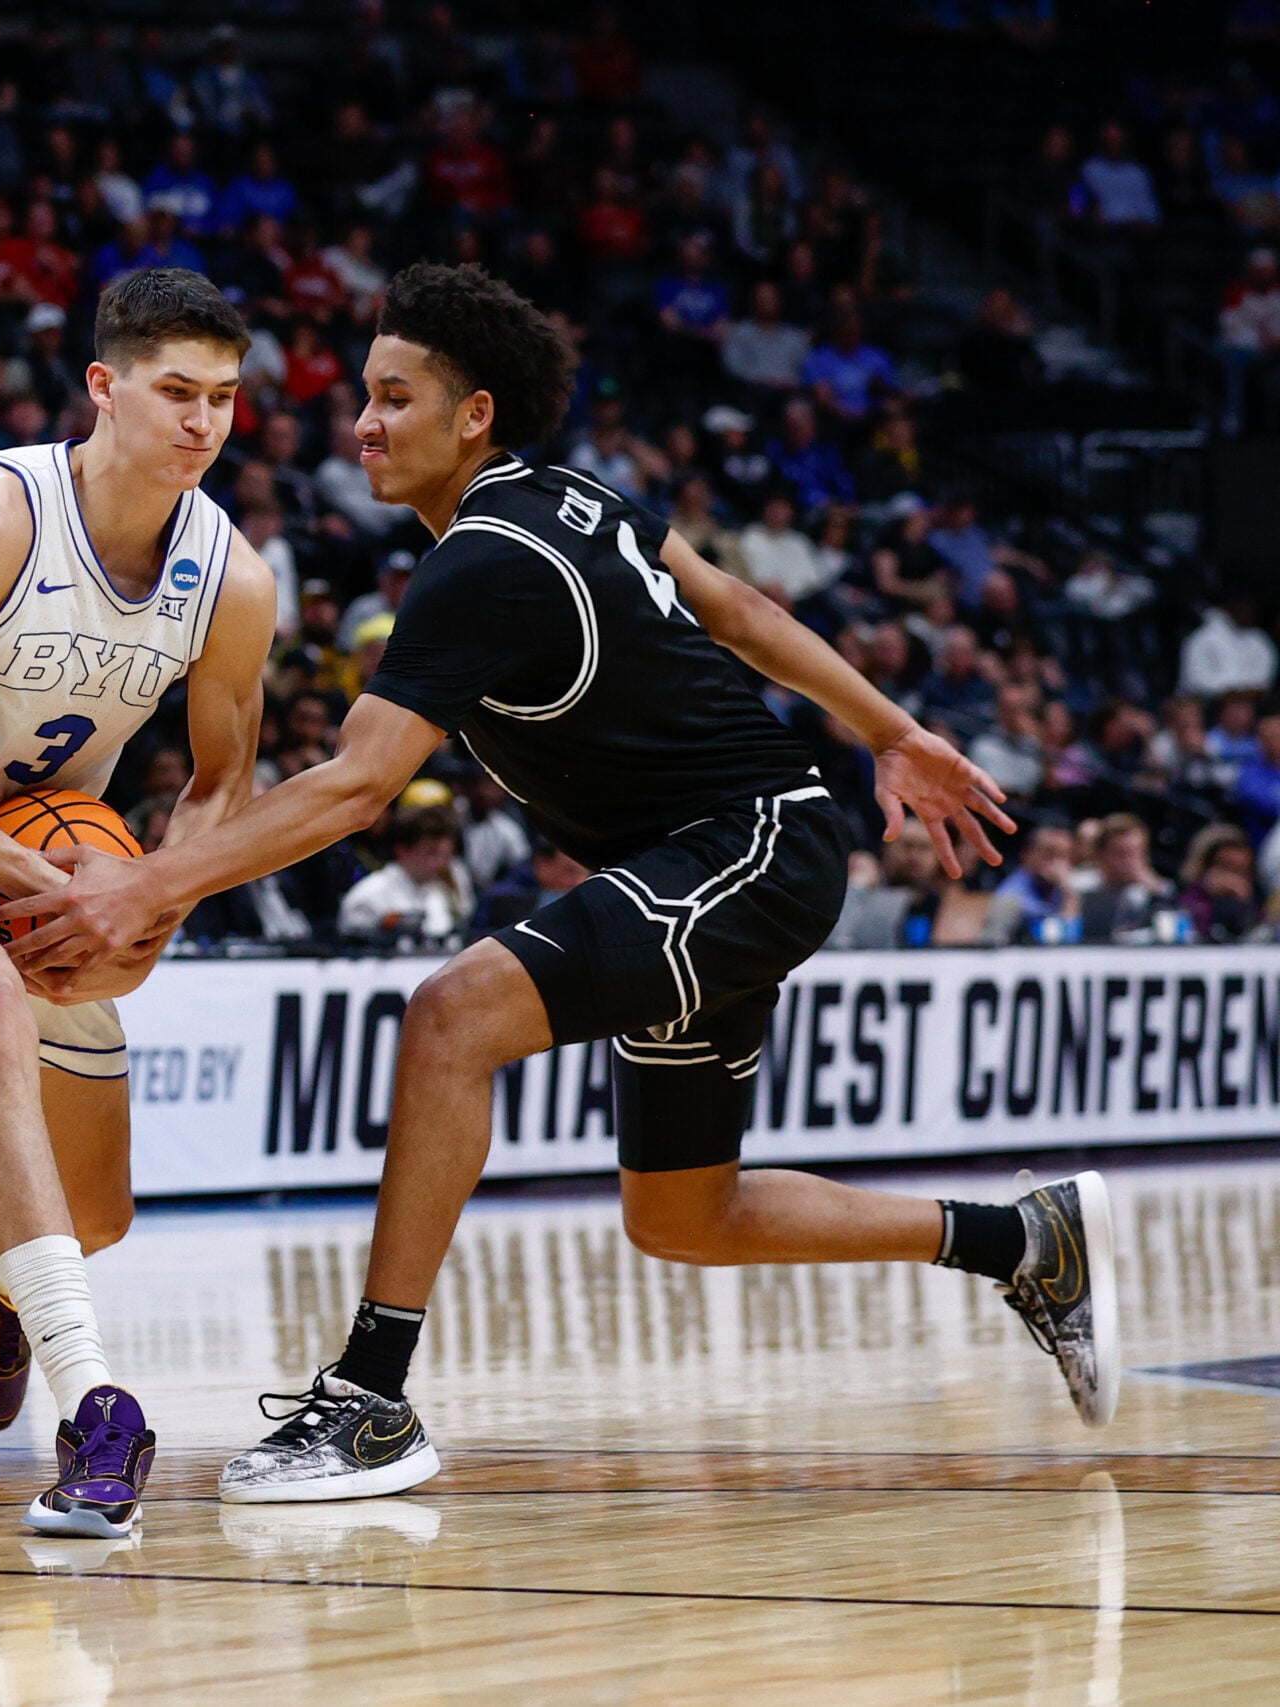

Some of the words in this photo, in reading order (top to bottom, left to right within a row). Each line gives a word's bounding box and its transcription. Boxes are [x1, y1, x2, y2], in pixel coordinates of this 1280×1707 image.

[173, 572, 200, 585] NCAA
[3, 713, 98, 786] 3
[195, 1044, 245, 1102] BY
